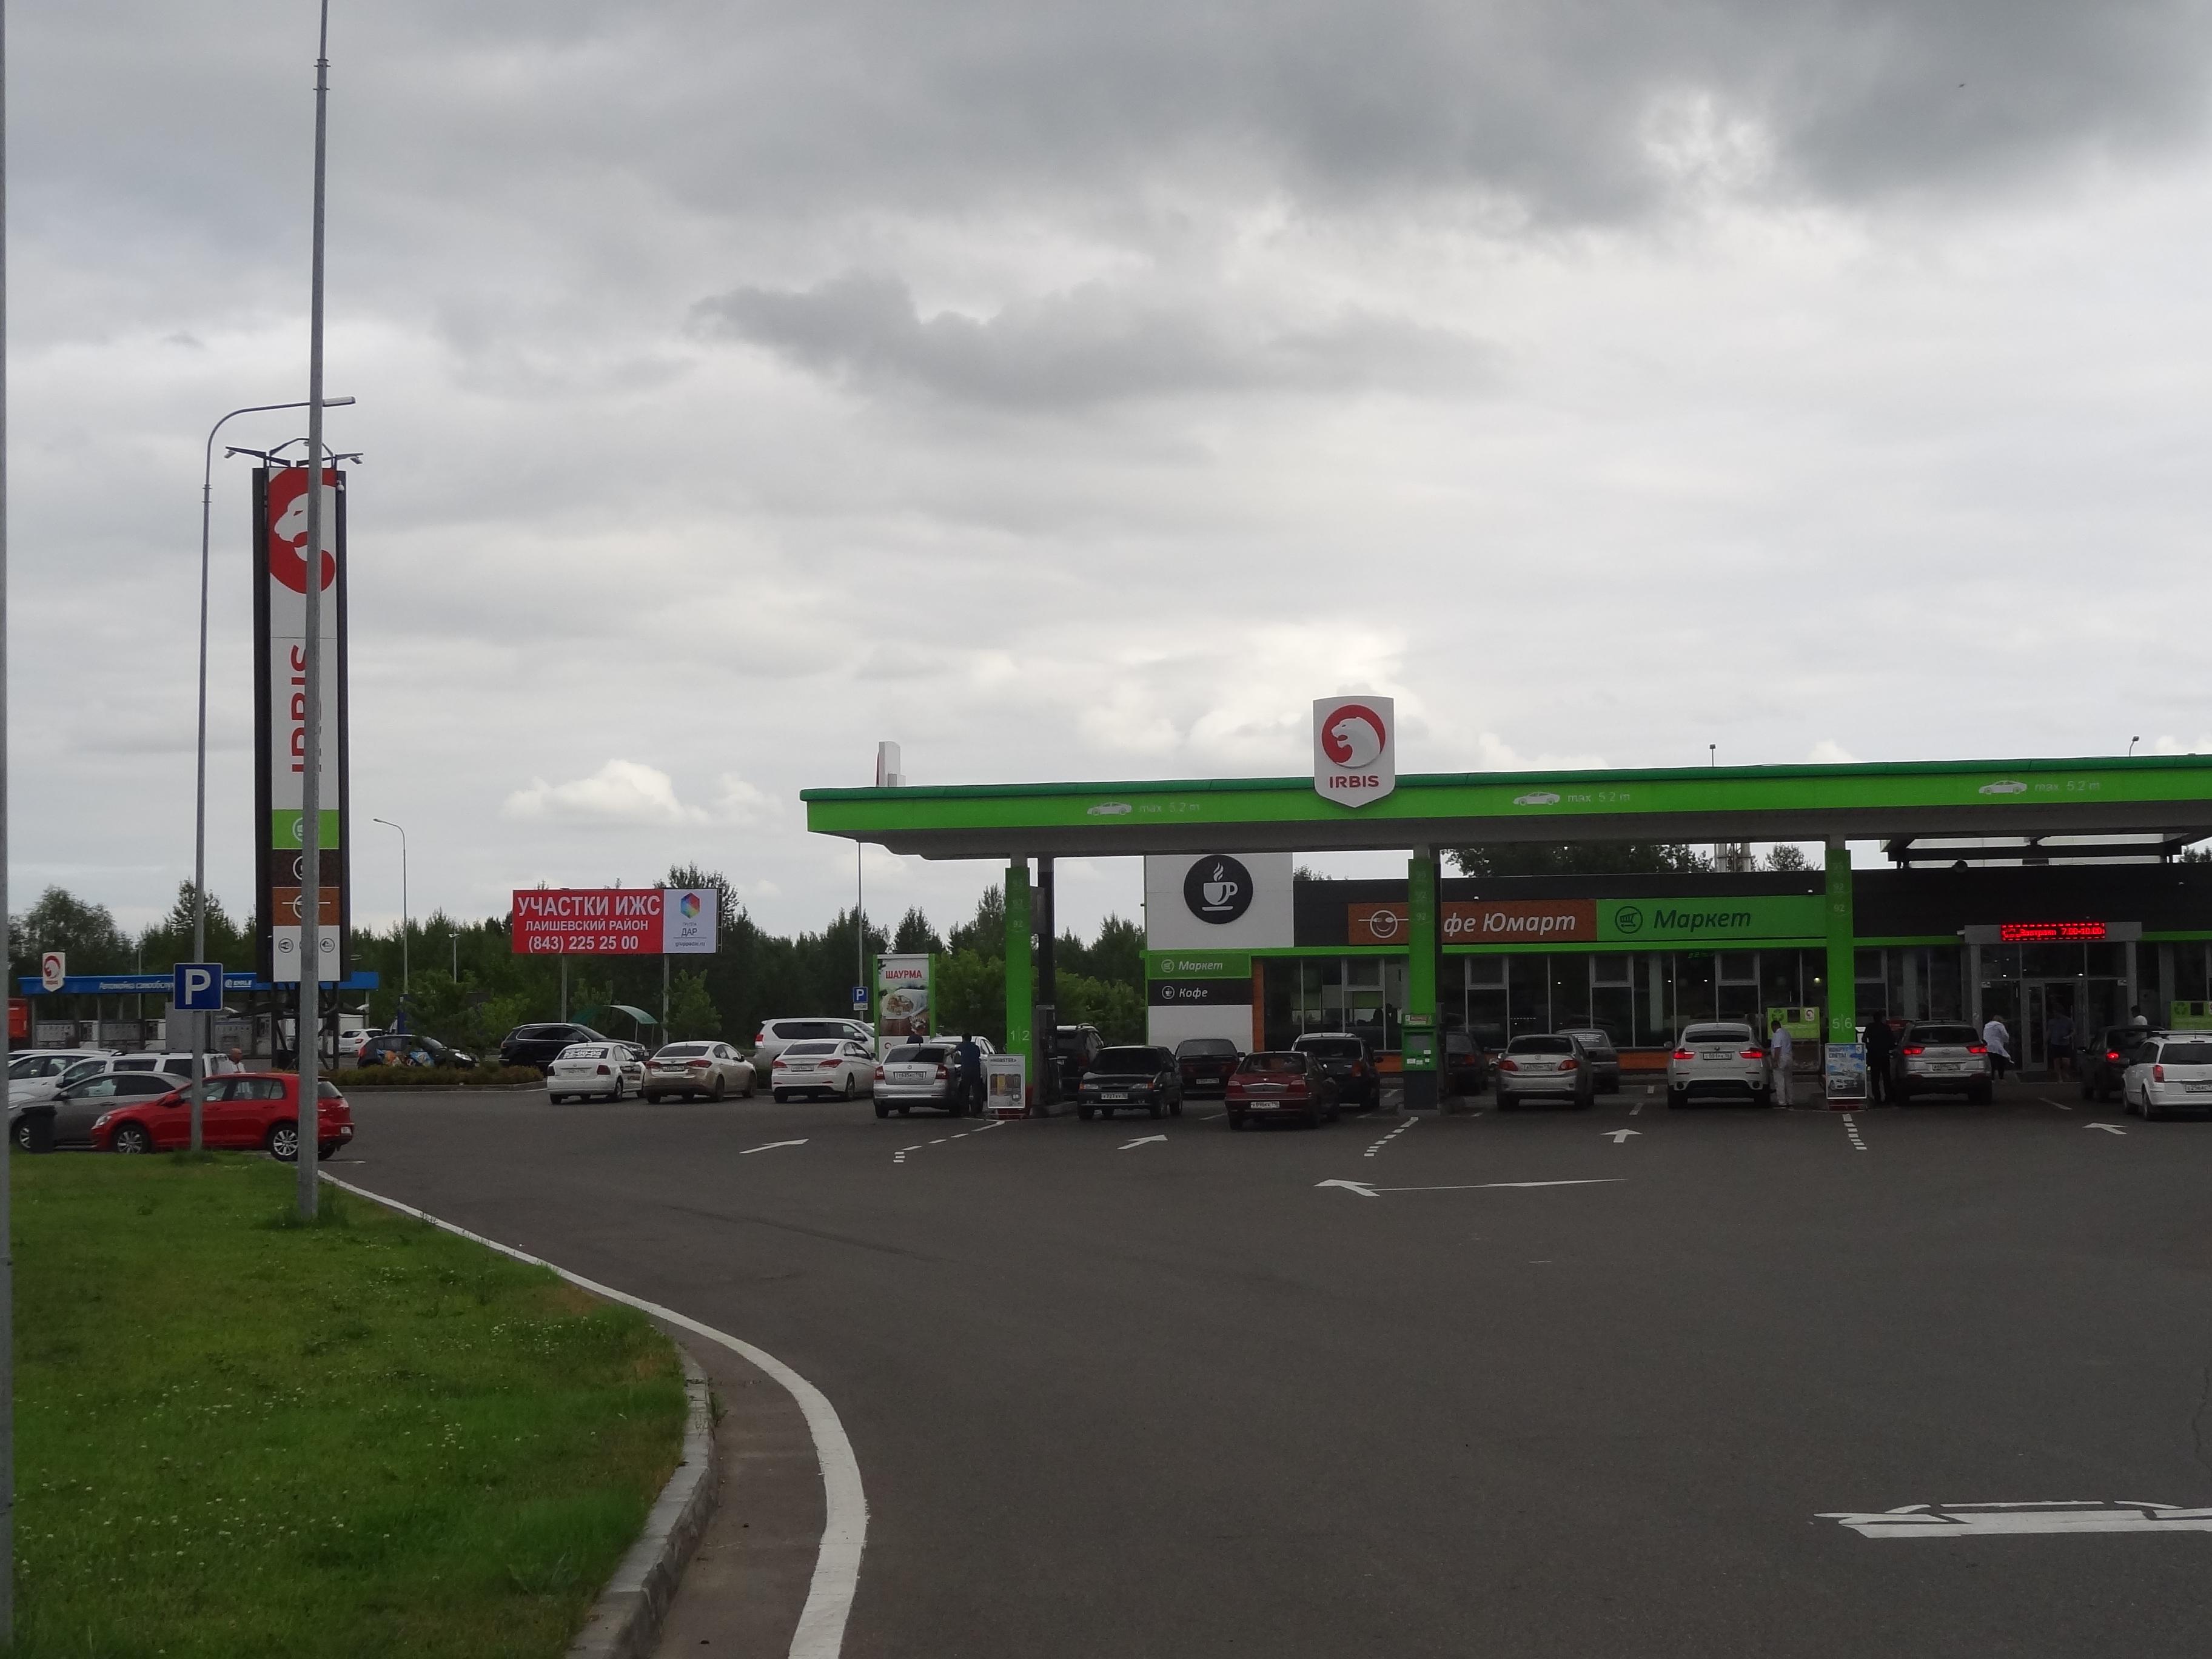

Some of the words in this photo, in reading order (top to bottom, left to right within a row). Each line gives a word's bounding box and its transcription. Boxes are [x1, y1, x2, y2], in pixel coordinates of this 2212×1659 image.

[1329, 776, 1379, 788] IRBIS
[2035, 783, 2059, 792] max
[1567, 794, 1592, 802] max
[1140, 803, 1162, 813] max
[517, 896, 609, 917] УЧАСТКИ
[615, 895, 661, 916] ИЖС
[525, 918, 606, 931] ЛАИШЕВСКИЙ
[609, 918, 648, 931] РАЙОН
[1443, 913, 1476, 937] фе
[1483, 913, 1575, 936] Юмарт
[1654, 910, 1751, 933] Маркет
[681, 928, 697, 937] ДАР
[528, 936, 564, 953] (843)
[569, 936, 594, 950] 225
[599, 936, 617, 950] 25
[621, 935, 638, 950] 00
[1178, 961, 1223, 973] Маркет
[885, 970, 922, 979] ШАУРМА
[184, 969, 212, 1005] P
[1179, 987, 1208, 999] Кофе
[856, 988, 865, 1000] P
